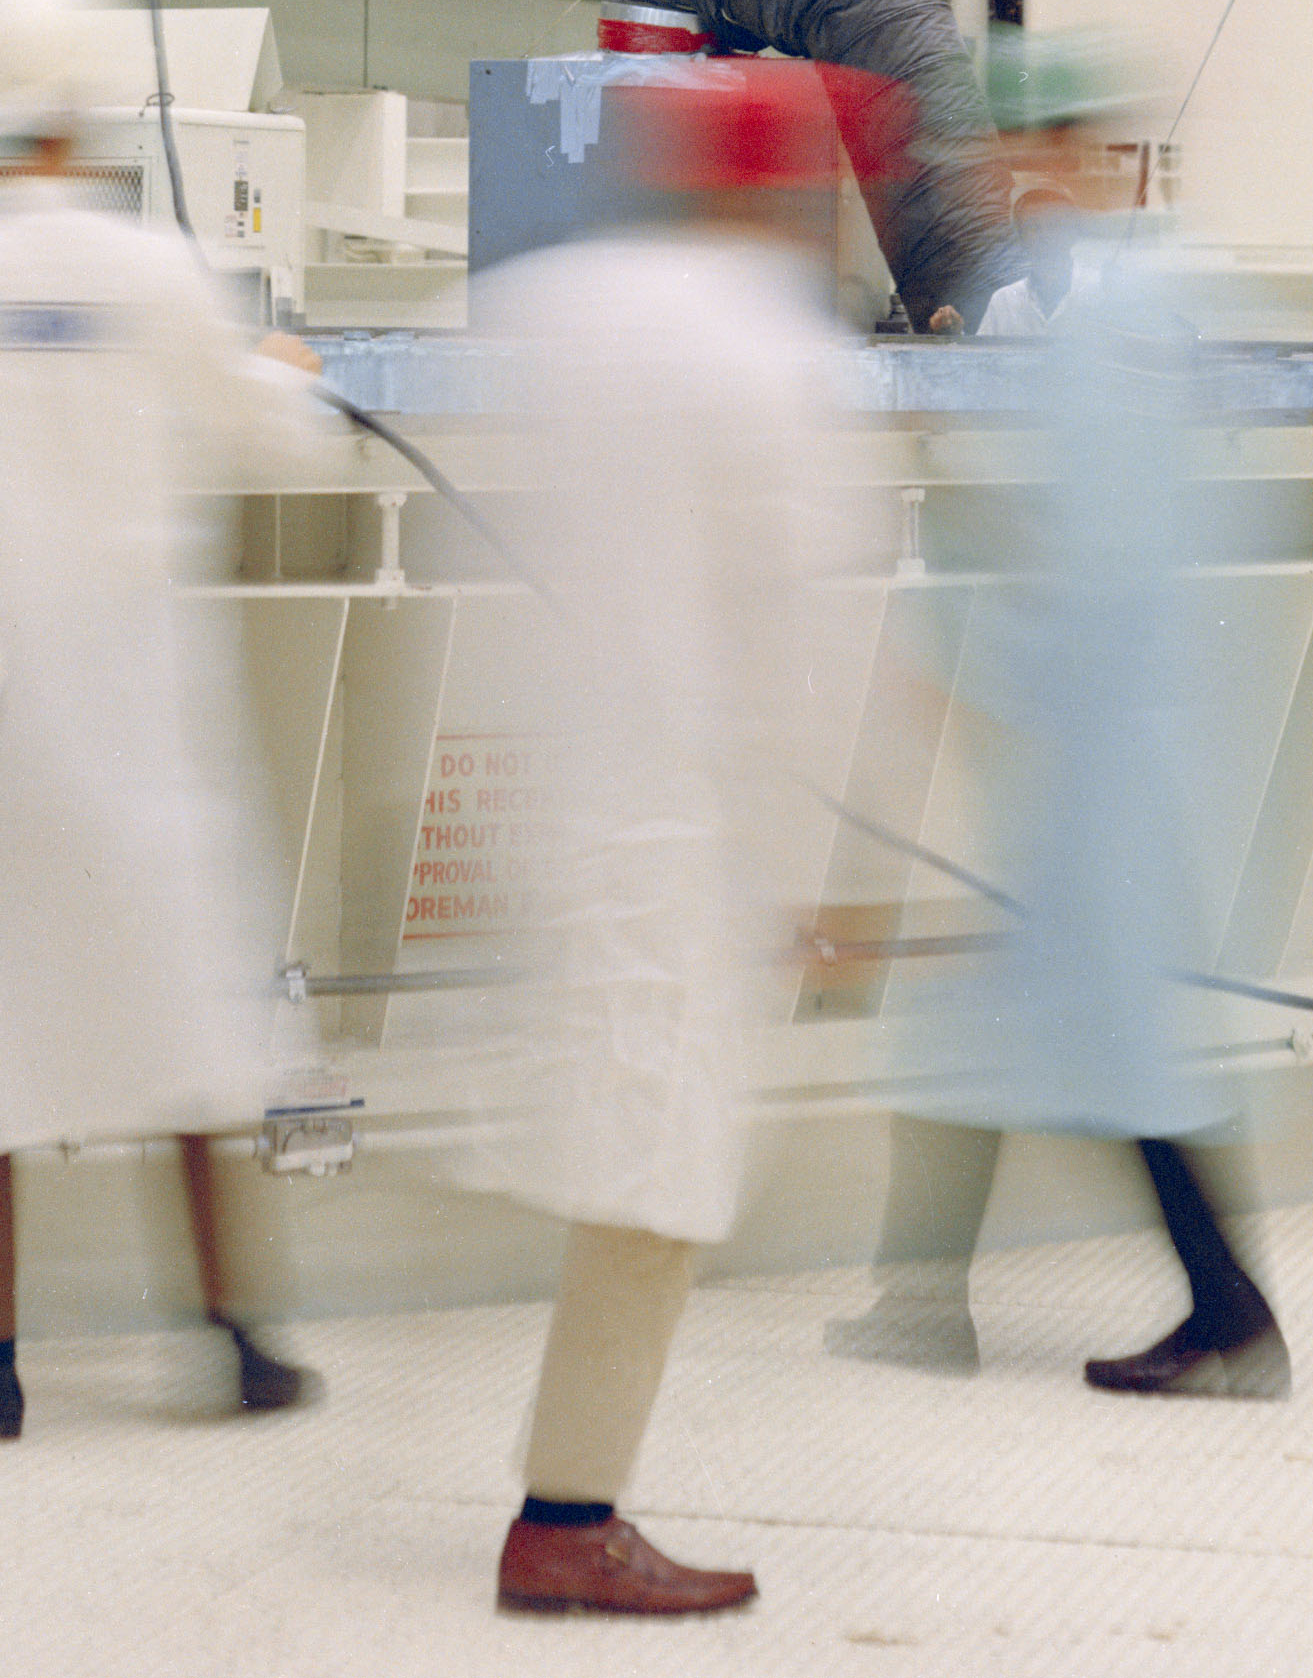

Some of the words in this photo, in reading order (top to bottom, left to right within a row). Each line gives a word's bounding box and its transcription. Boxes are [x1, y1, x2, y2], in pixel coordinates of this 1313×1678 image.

[441, 753, 475, 778] DO
[425, 787, 461, 814] HIS
[418, 823, 502, 850] THOUT
[407, 894, 508, 922] OREMAN
